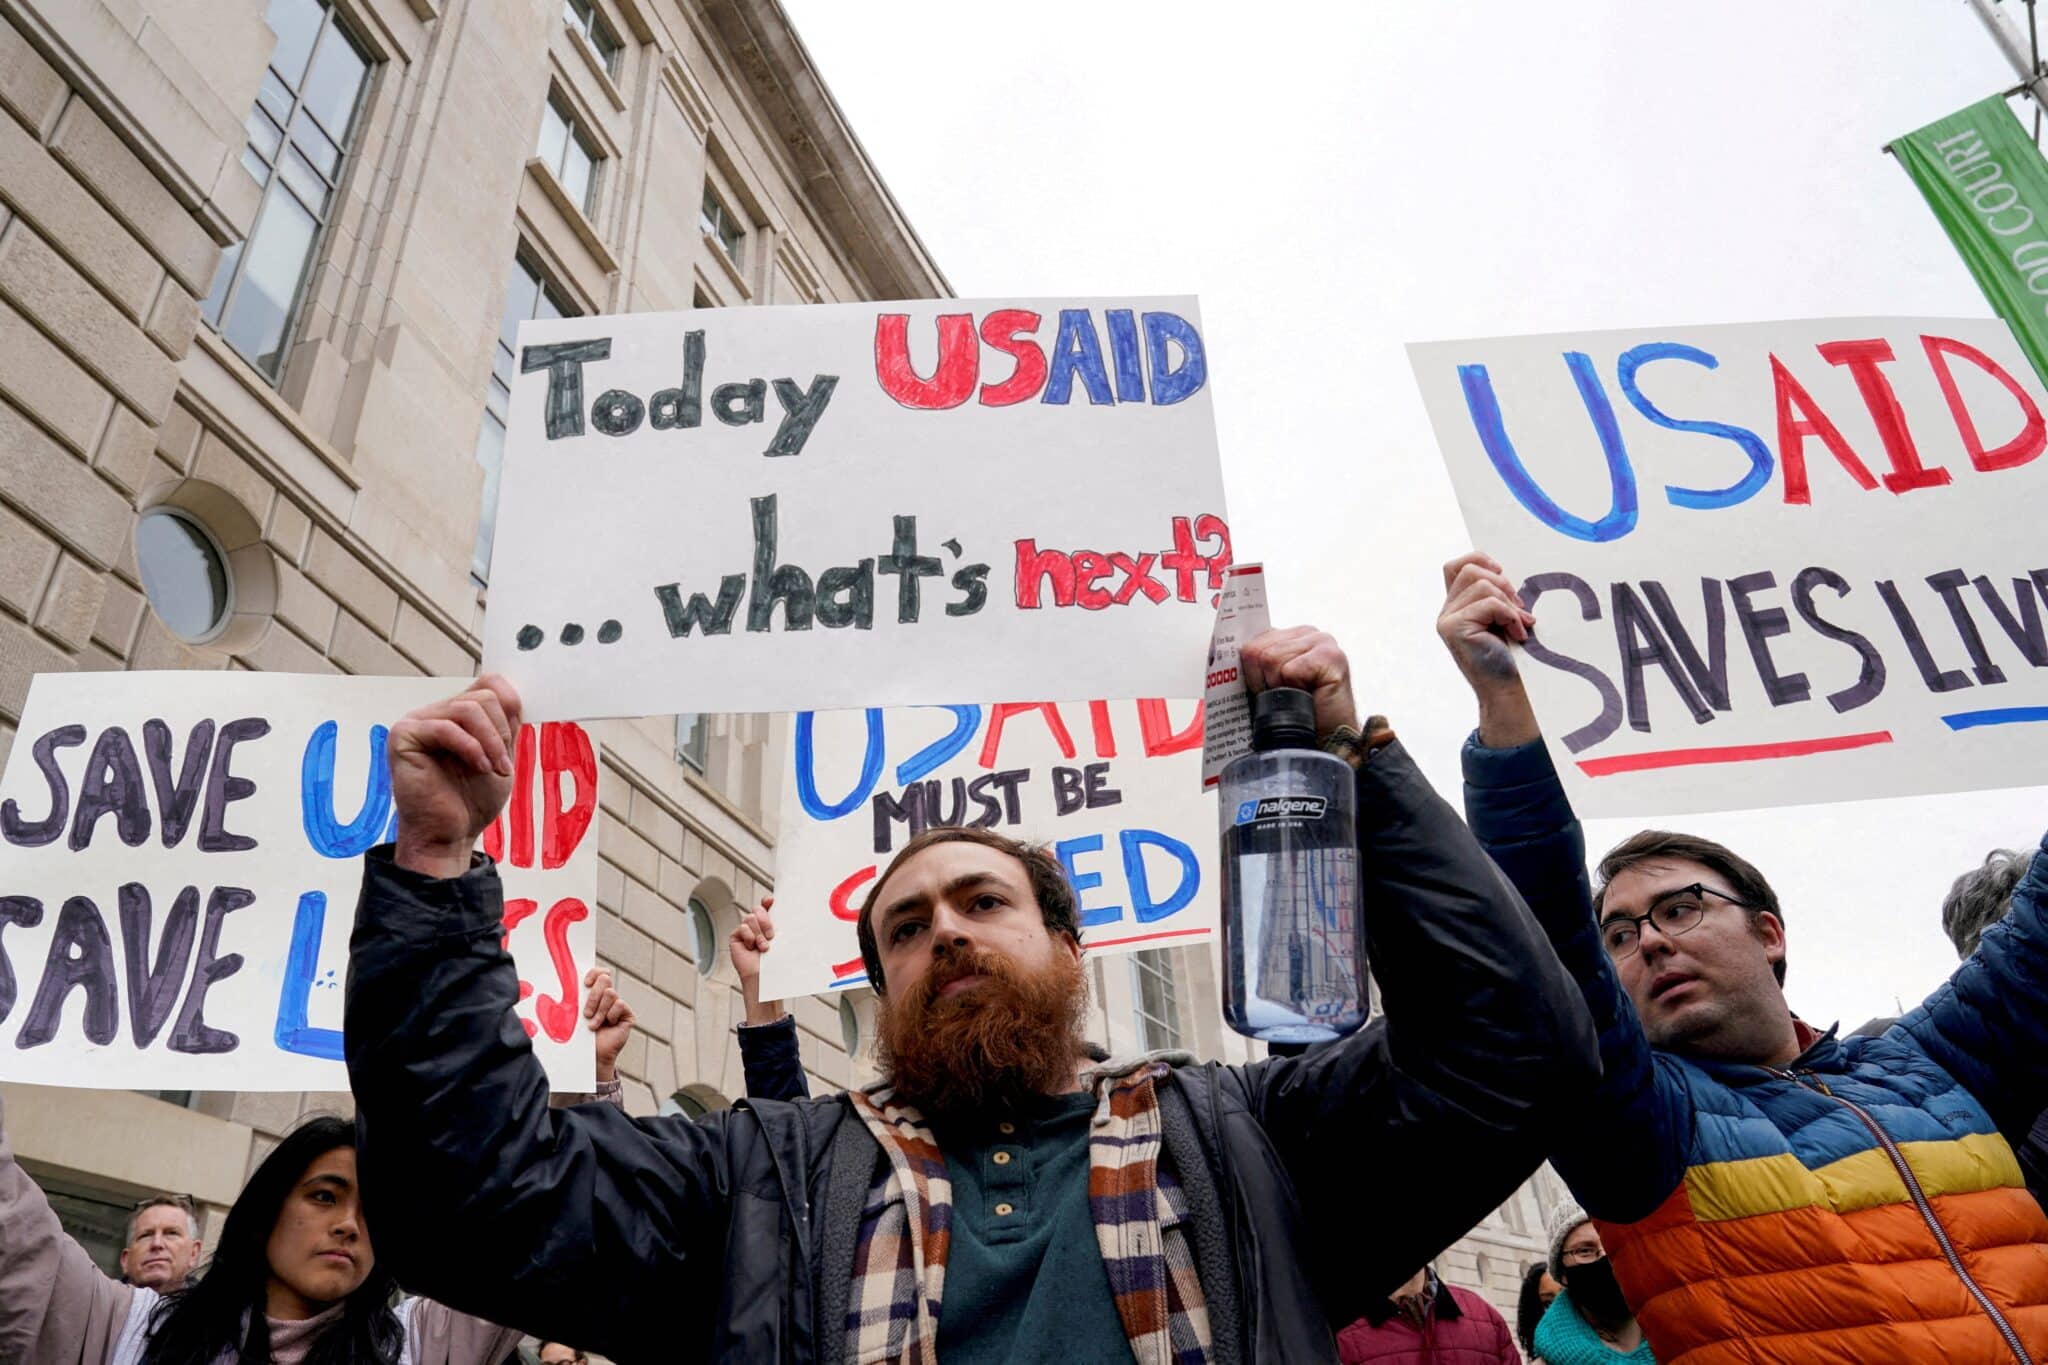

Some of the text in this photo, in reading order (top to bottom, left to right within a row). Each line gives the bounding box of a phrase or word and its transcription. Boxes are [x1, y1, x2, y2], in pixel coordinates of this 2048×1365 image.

[1932, 128, 2035, 236] COURT
[520, 309, 1205, 457] Today USAID
[1457, 334, 2048, 542] USAID
[655, 493, 990, 638] what's
[1015, 513, 1233, 610] next?
[1518, 567, 1886, 754] SAVES
[0, 716, 598, 869] SAVE UID
[872, 762, 1122, 853] MUST BE
[1257, 799, 1321, 815] nalgene
[0, 881, 257, 1055] SAVE
